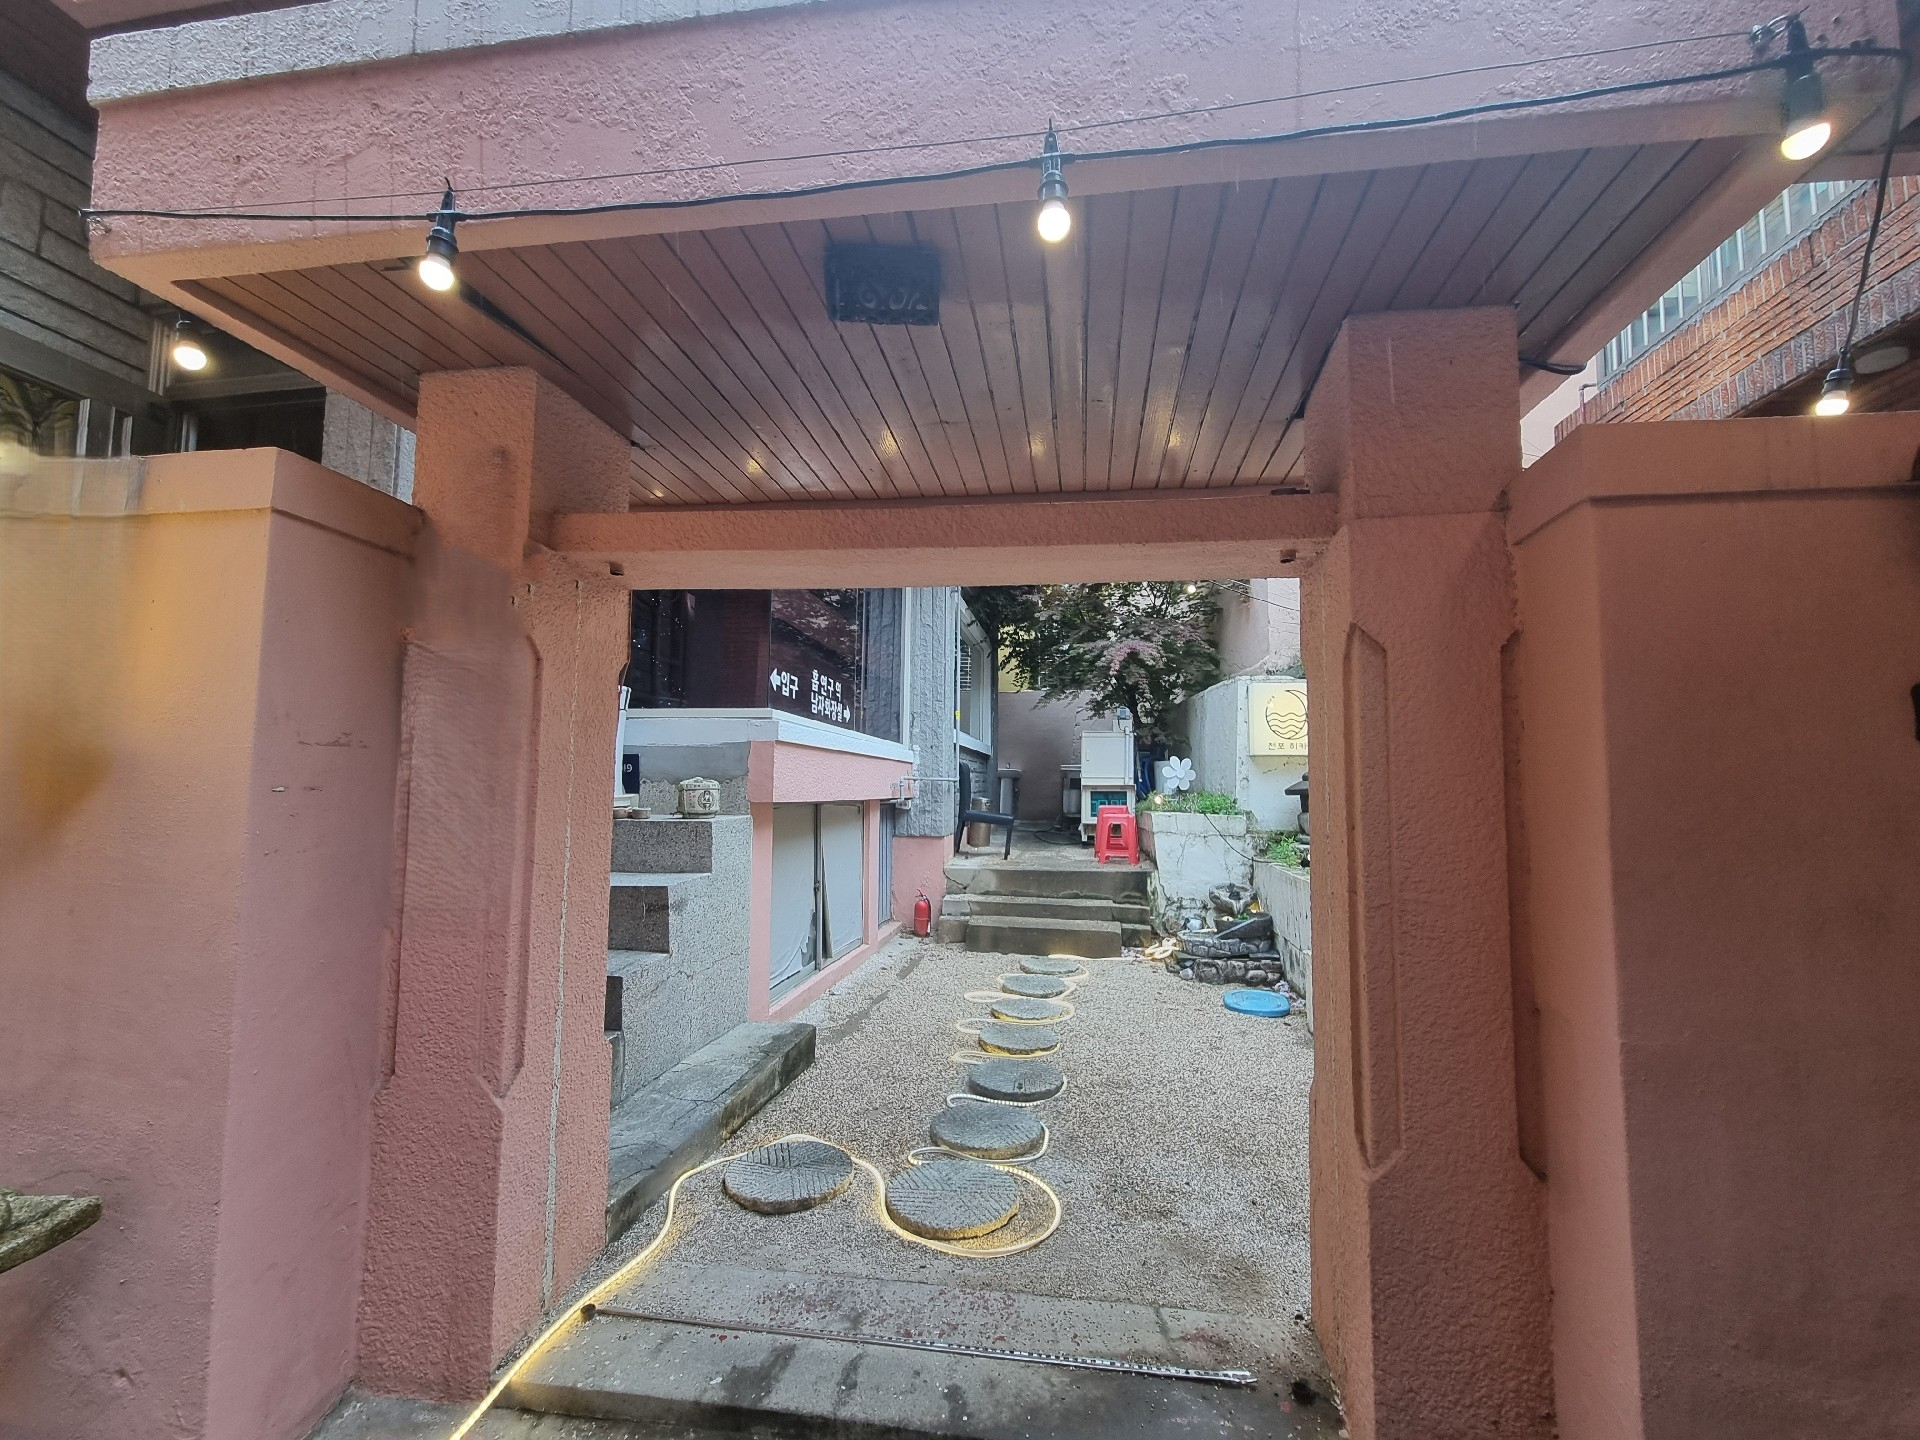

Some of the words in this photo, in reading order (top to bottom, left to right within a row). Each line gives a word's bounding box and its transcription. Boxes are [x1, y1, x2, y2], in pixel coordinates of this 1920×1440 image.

[781, 671, 799, 699] 입구
[811, 669, 842, 701] 흡연구역
[811, 692, 843, 722] 남자화장실
